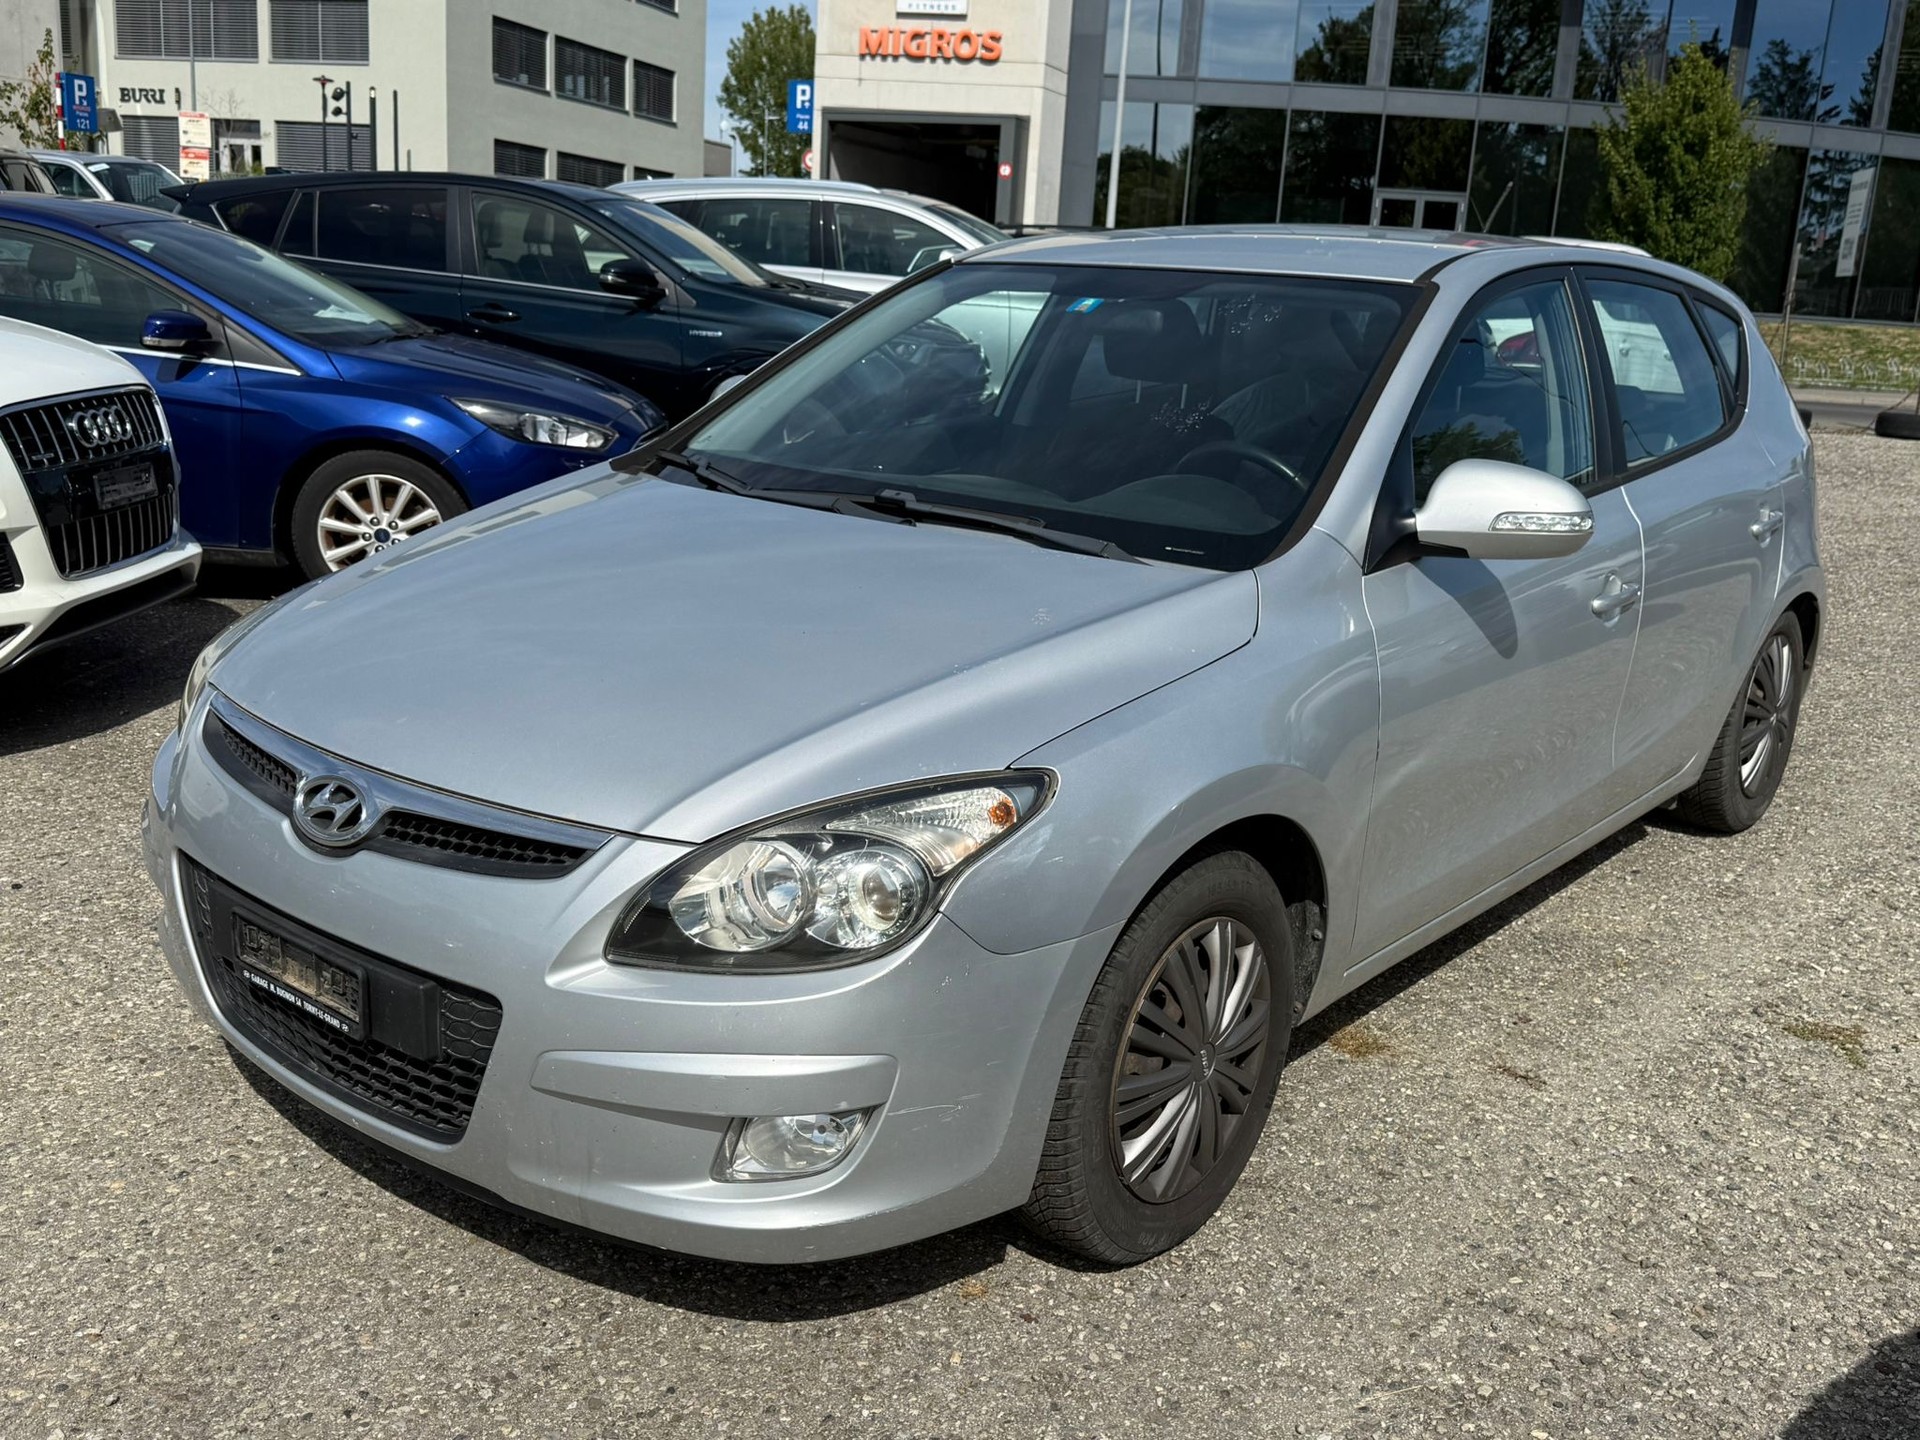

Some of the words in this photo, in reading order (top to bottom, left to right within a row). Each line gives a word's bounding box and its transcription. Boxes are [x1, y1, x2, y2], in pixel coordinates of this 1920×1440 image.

[907, 3, 957, 11] FITNESS
[858, 26, 1003, 62] MIGROS
[73, 79, 88, 105] P
[119, 87, 166, 105] BURRI
[796, 84, 811, 109] P
[76, 118, 91, 130] 121
[797, 121, 809, 130] 44
